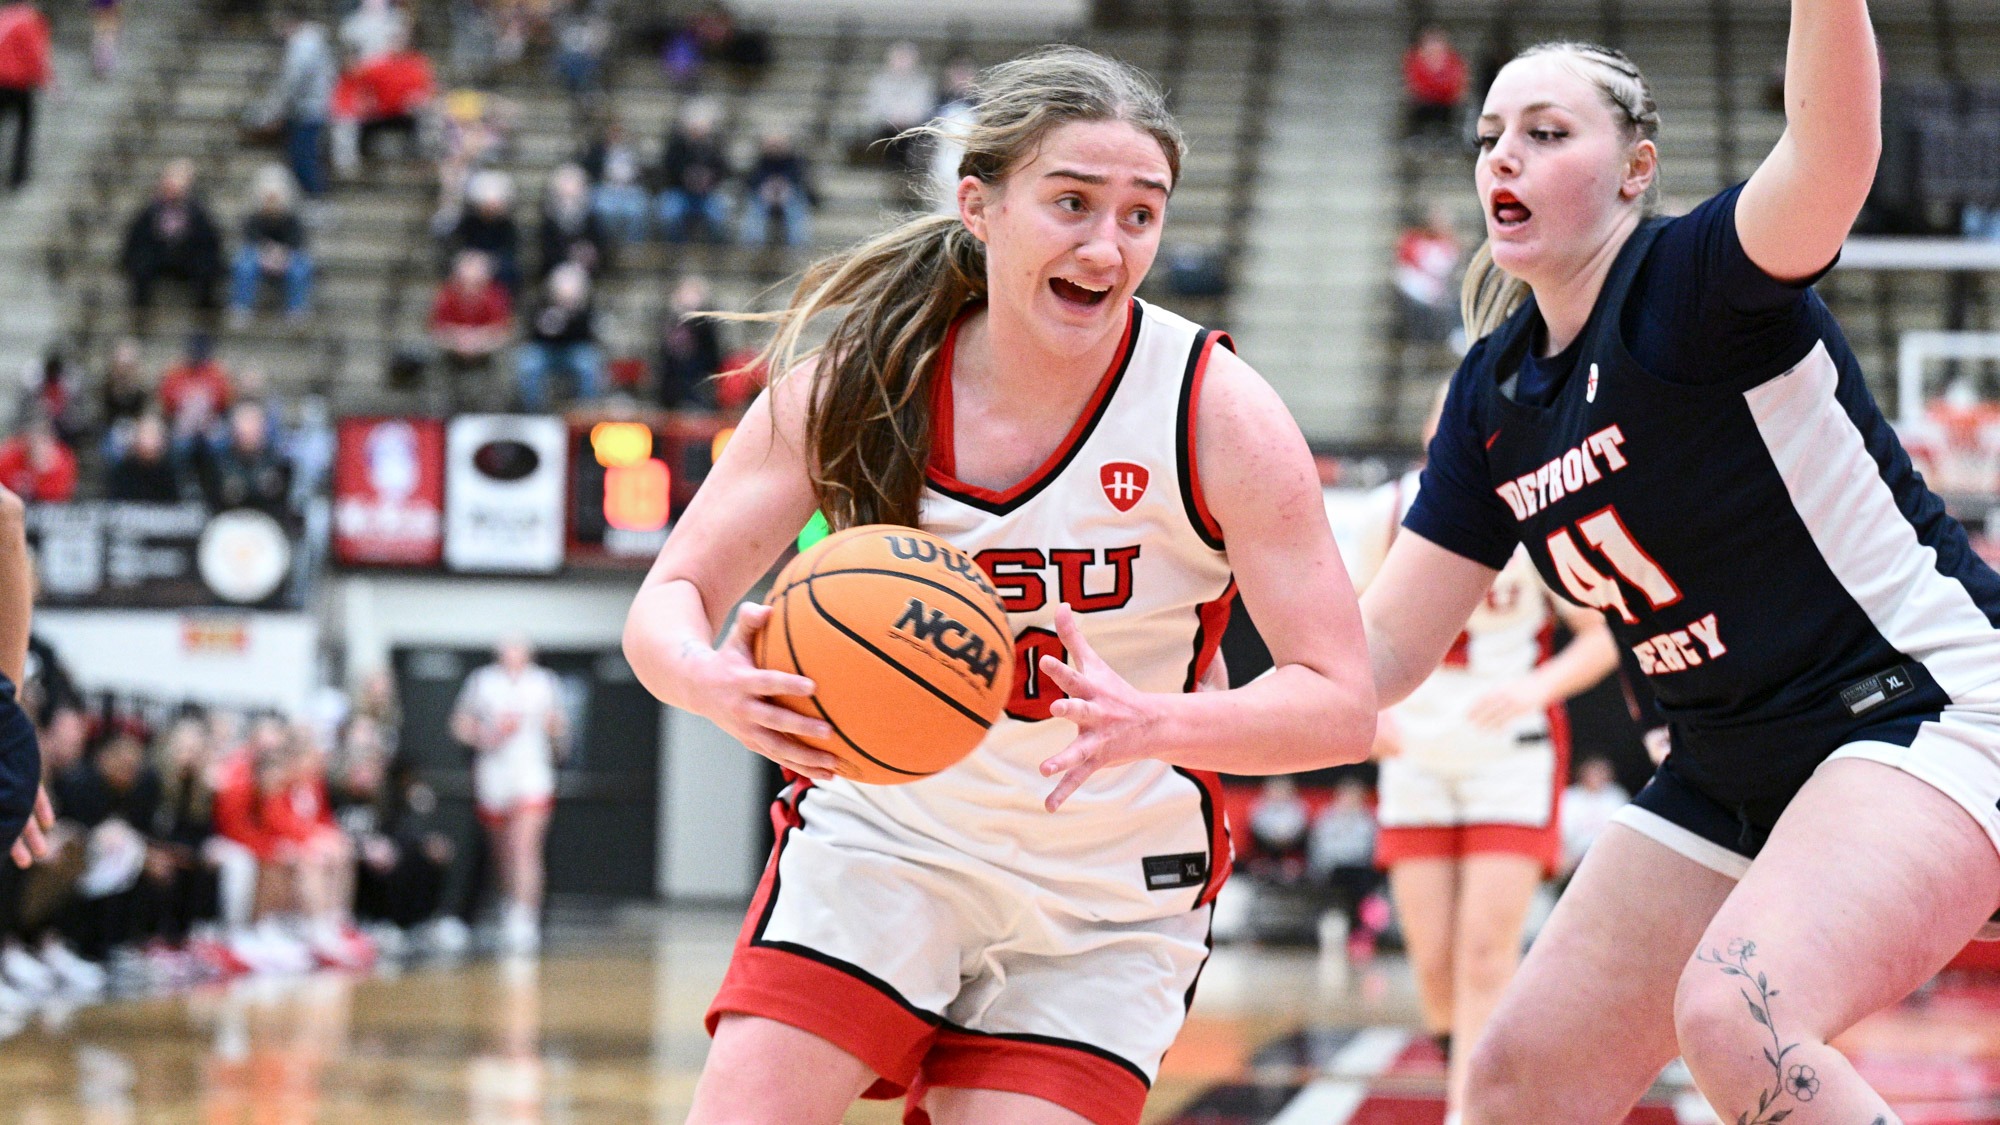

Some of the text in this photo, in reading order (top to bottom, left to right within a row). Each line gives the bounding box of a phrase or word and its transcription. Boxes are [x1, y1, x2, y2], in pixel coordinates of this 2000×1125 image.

[1495, 423, 1629, 522] DETROIT
[962, 544, 1141, 614] SU
[1546, 503, 1684, 624] 41
[891, 597, 1001, 690] NCAA
[1631, 612, 1727, 675] ERCY
[1886, 675, 1904, 690] XL
[1185, 863, 1199, 876] XL
